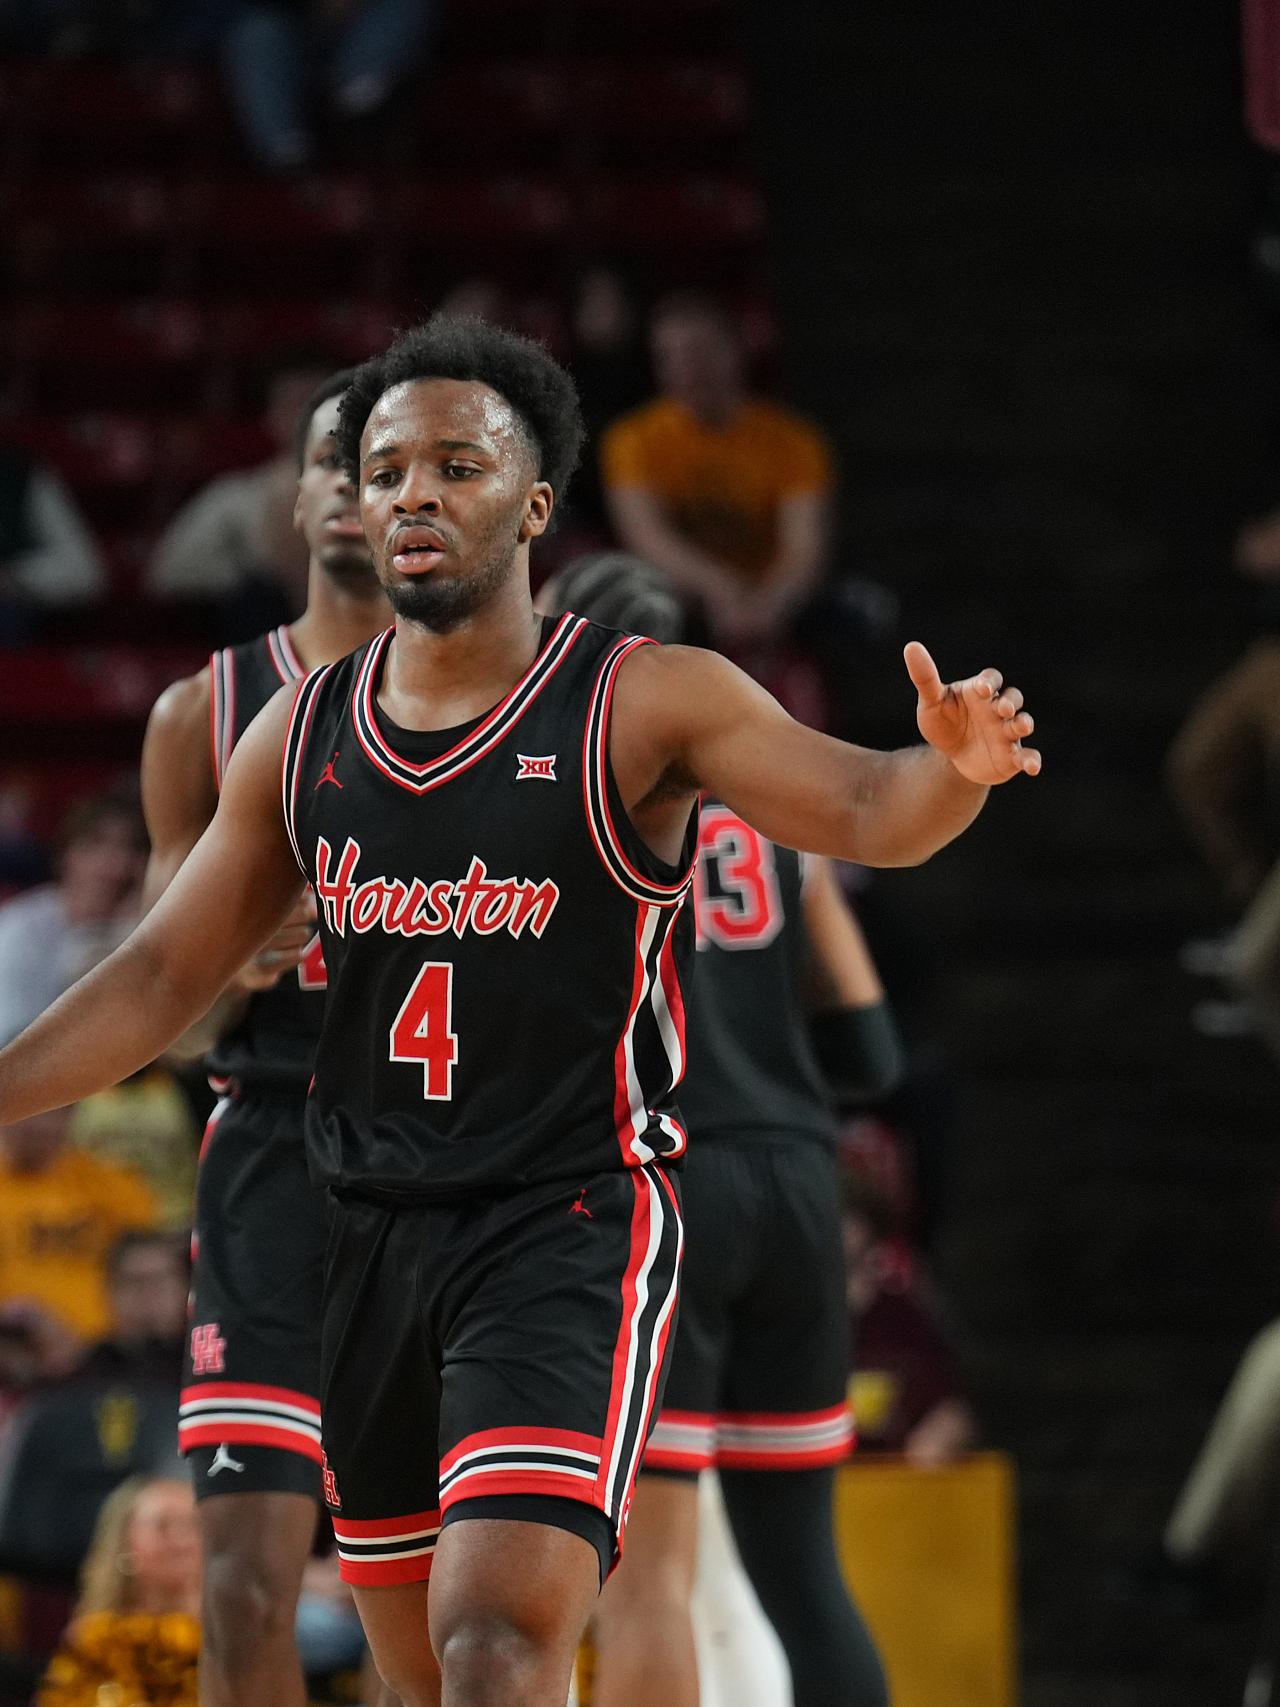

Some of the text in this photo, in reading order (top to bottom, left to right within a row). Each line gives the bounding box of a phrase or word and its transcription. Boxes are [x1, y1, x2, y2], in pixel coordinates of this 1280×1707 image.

[519, 758, 554, 777] XII
[316, 836, 560, 940] Houston
[389, 961, 459, 1101] 4
